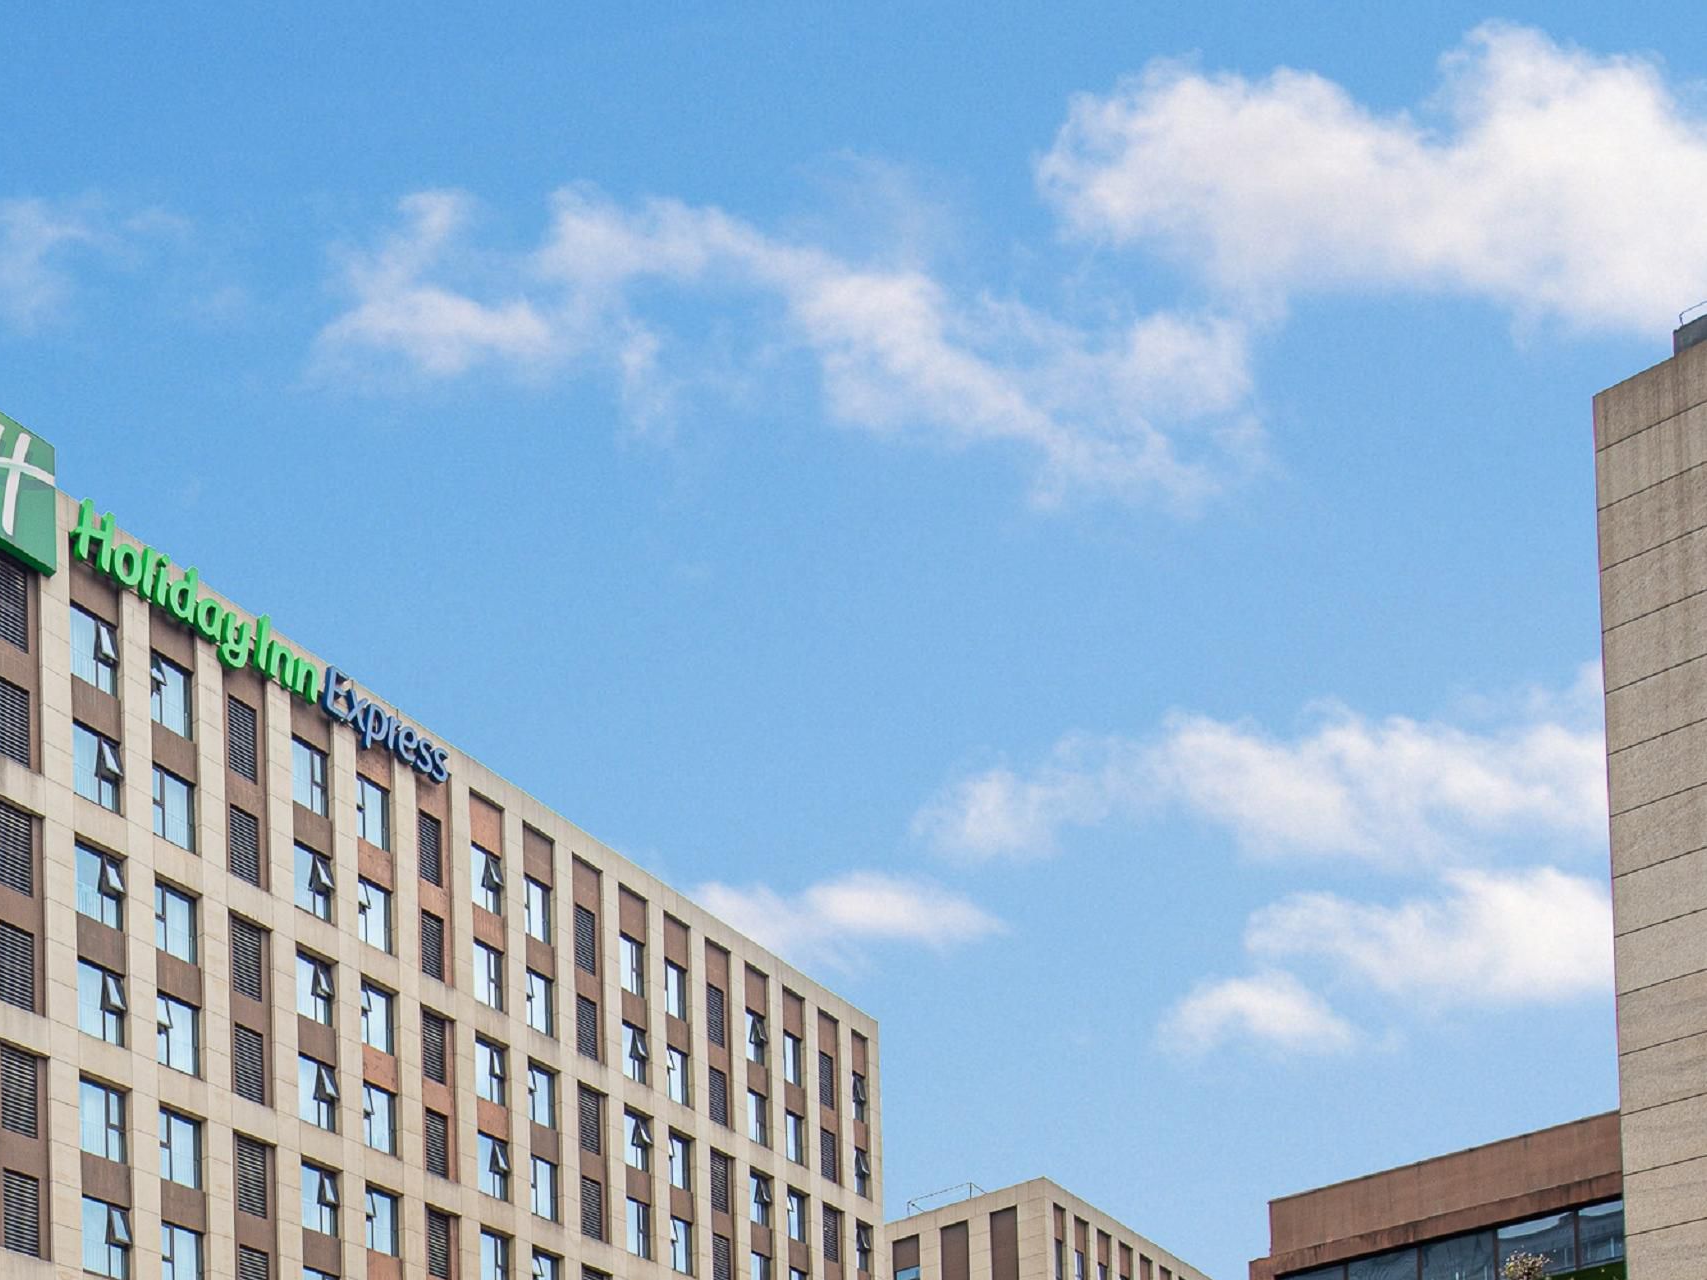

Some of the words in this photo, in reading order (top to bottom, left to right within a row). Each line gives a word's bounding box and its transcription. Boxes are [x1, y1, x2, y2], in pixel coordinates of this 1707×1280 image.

[70, 497, 252, 669] Holiday
[253, 613, 319, 704] Inn
[322, 664, 450, 784] Express
